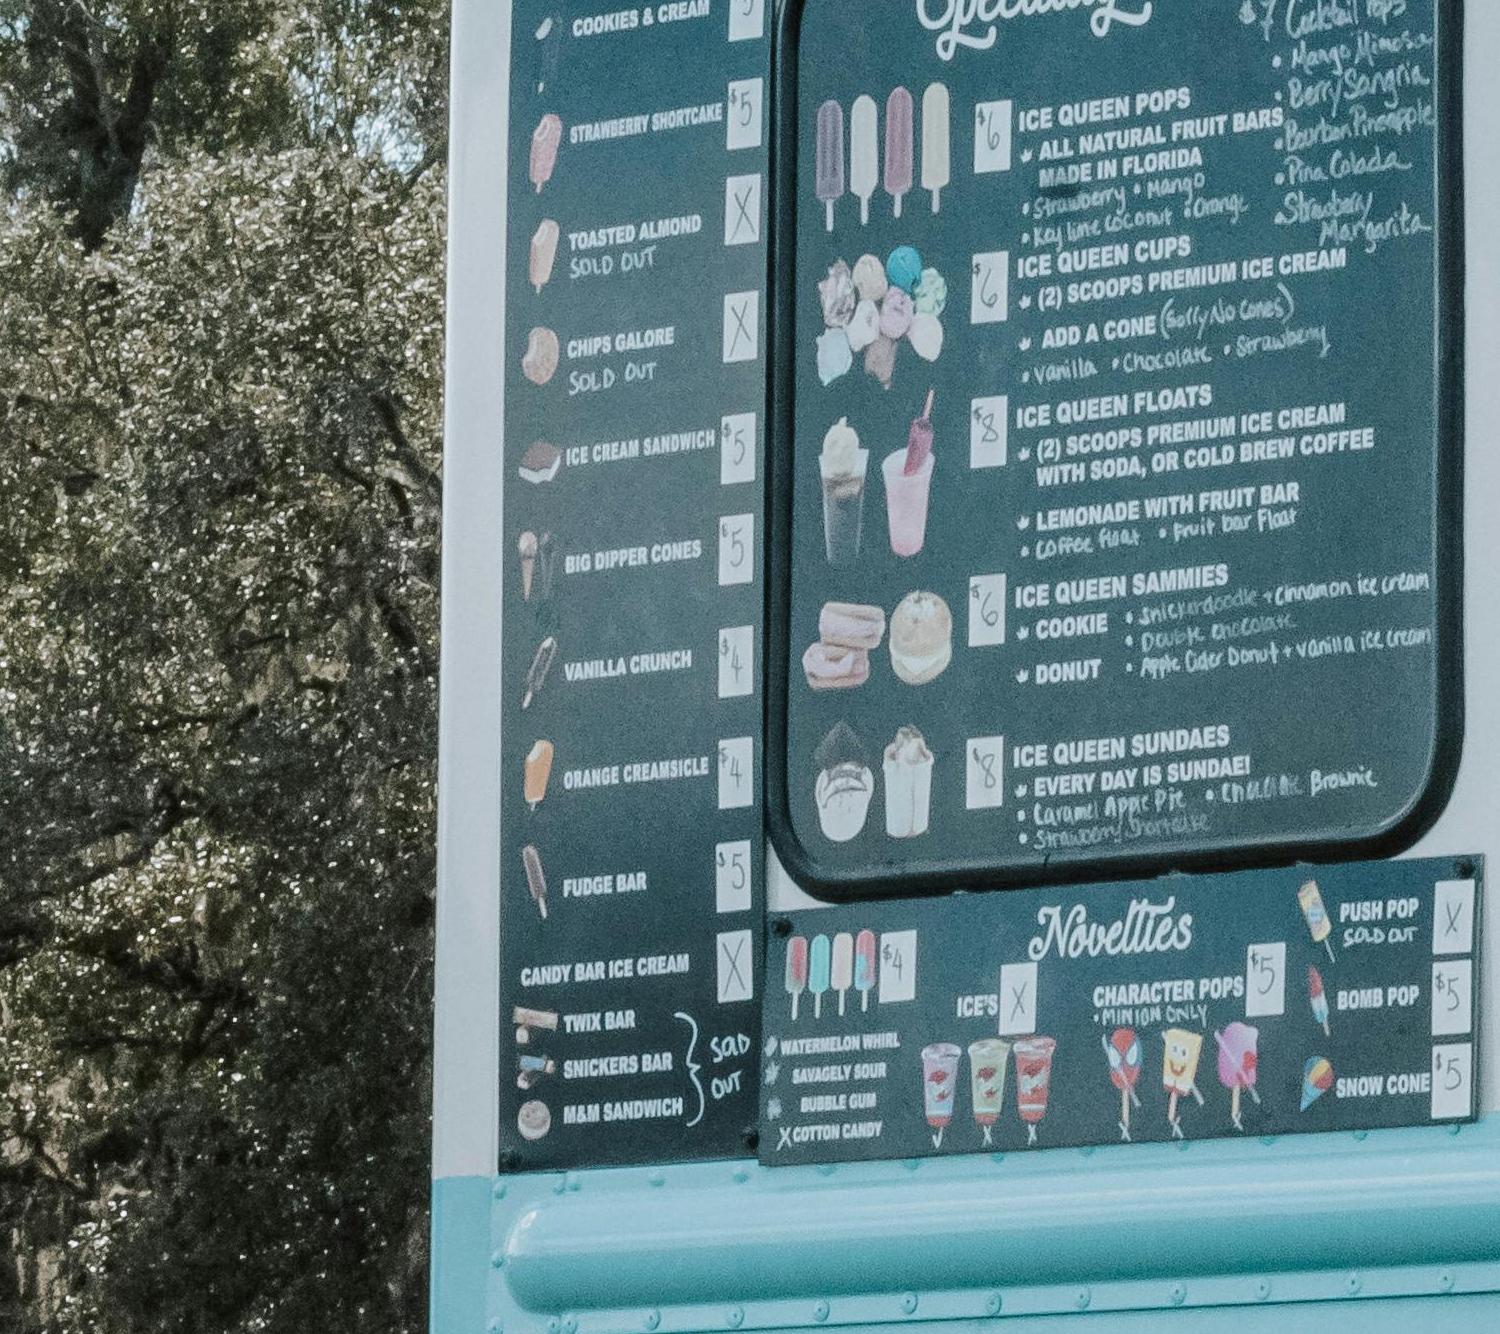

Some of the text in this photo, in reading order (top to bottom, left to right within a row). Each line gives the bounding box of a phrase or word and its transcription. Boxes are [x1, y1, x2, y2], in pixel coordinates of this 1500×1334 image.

[571, 7, 639, 37] COOKIES
[641, 6, 654, 27] &
[568, 102, 723, 144] STRAWBERRY SHORTCAKE
[1017, 86, 1192, 133] ICE QUEEN POPS
[1038, 106, 1284, 161] ALL NATURAL FRUIT BARS
[1038, 146, 1202, 187] MADE IN FLORIDA
[567, 214, 702, 251] TOASTED ALMOND
[1016, 234, 1191, 279] ICE QUEEN CUPS
[1037, 247, 1346, 311] (2) SCOOPS PREMIUM ICE CREAM
[566, 326, 675, 360] CHIPS GALORE
[1041, 315, 1156, 349] ADD A CONE
[1015, 382, 1212, 429] ICE QUEEN FLOATS
[565, 428, 716, 466] ICE CREAM SANDWICH
[1036, 401, 1345, 463] (2) SCOOPS PREMIUM ICE CREAM
[1036, 427, 1375, 487] WITH SODA, OR COLD BREW COFFEE
[1035, 481, 1299, 531] LEMONADE WITH FRUIT BAR
[564, 539, 702, 575] BIG DIPPER CONES
[1014, 563, 1229, 608] ICE QUEEN SAMMIES
[1034, 612, 1109, 640] COOKIE
[563, 649, 692, 682] VANILLA CRUNCH
[1034, 659, 1102, 684] DONUT
[1012, 723, 1230, 769] ICE QUEEN SUNDAES
[562, 756, 710, 790] ORANGE CREAMSICLE
[1033, 754, 1251, 797] EVERY DAY IS SUNDAE!
[562, 870, 647, 898] FUDGE BAR
[1338, 896, 1419, 924] PUSH POP
[1028, 895, 1193, 964] Novelties
[520, 953, 690, 987] CANDY BAR ICE CREAM
[956, 993, 998, 1018] ICE'S
[1092, 974, 1244, 1008] CHARACTER POPS
[1336, 984, 1419, 1011] BOMB POP
[562, 1051, 673, 1080] SNICKERS BAR
[1334, 1072, 1430, 1098] SNOW CONE
[562, 1097, 684, 1124] M&M SANDWICH
